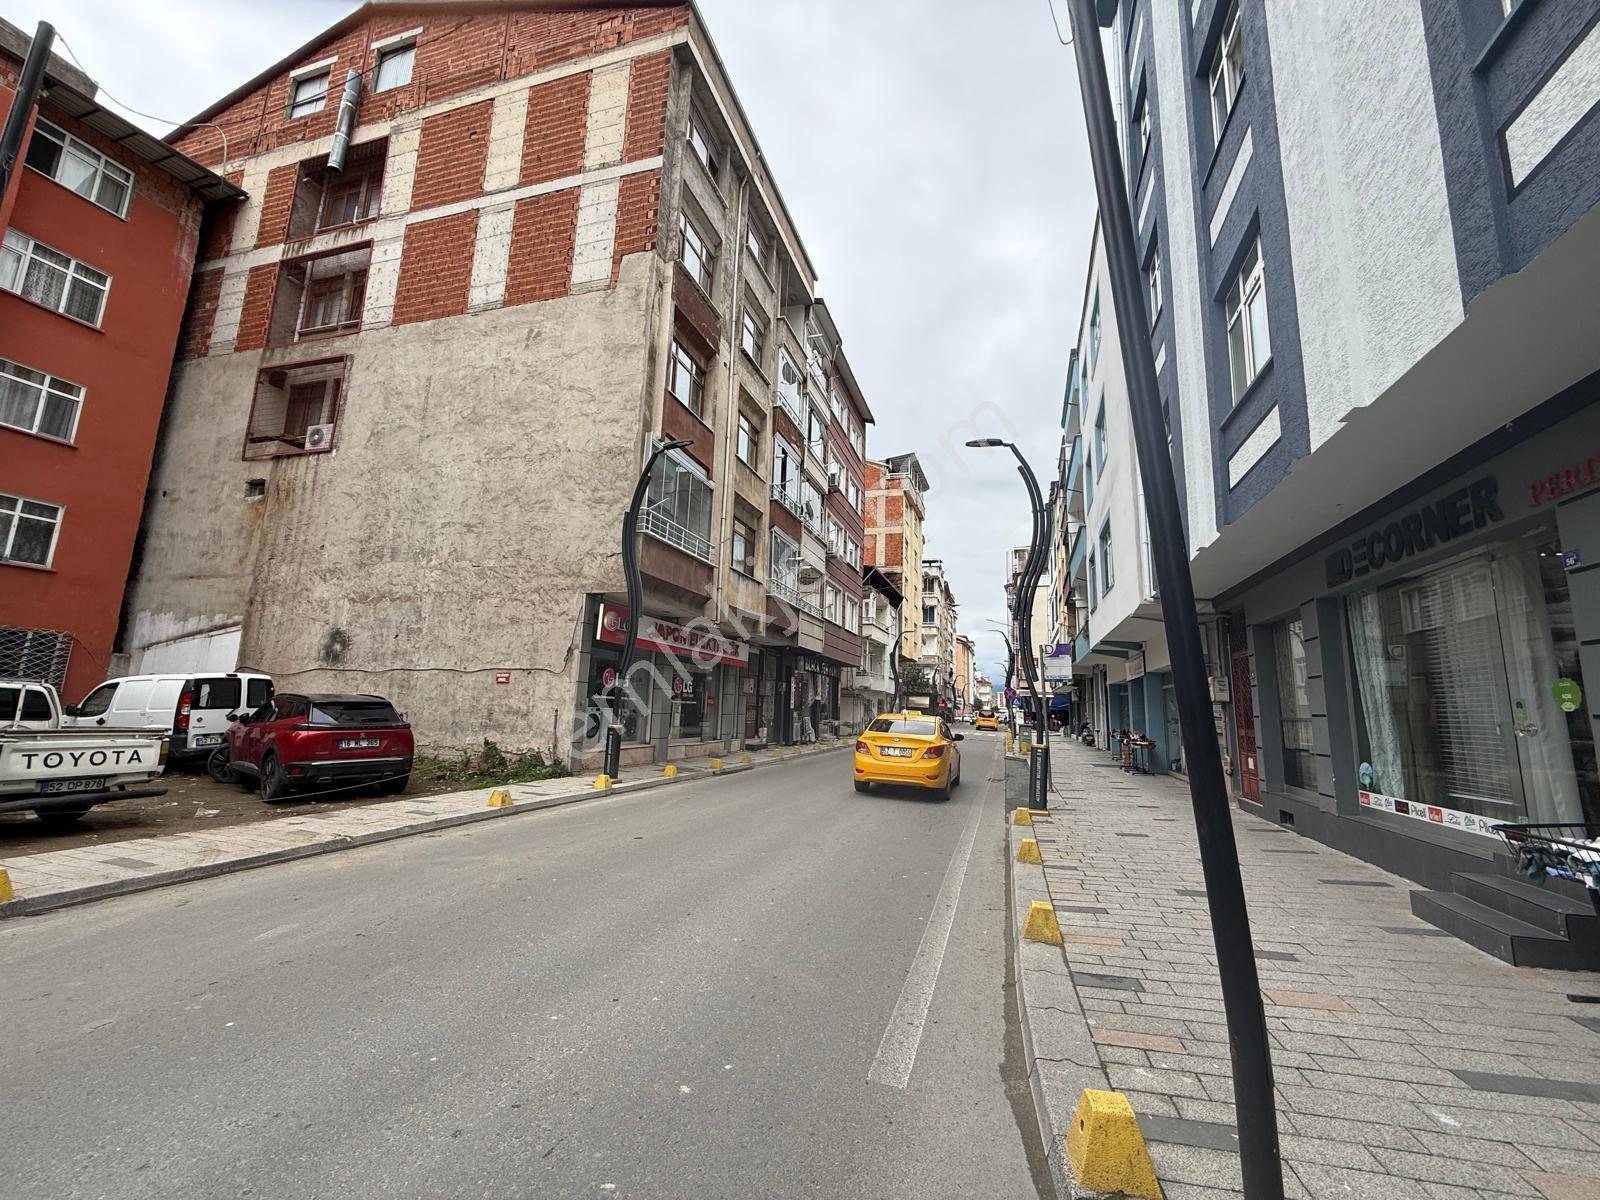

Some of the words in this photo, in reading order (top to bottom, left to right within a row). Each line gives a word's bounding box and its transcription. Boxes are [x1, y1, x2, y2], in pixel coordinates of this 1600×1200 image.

[1325, 476, 1504, 588] DECORNER
[683, 680, 693, 693] LG
[21, 749, 143, 770] TOYOTA
[49, 782, 63, 792] 52
[67, 781, 83, 790] DP
